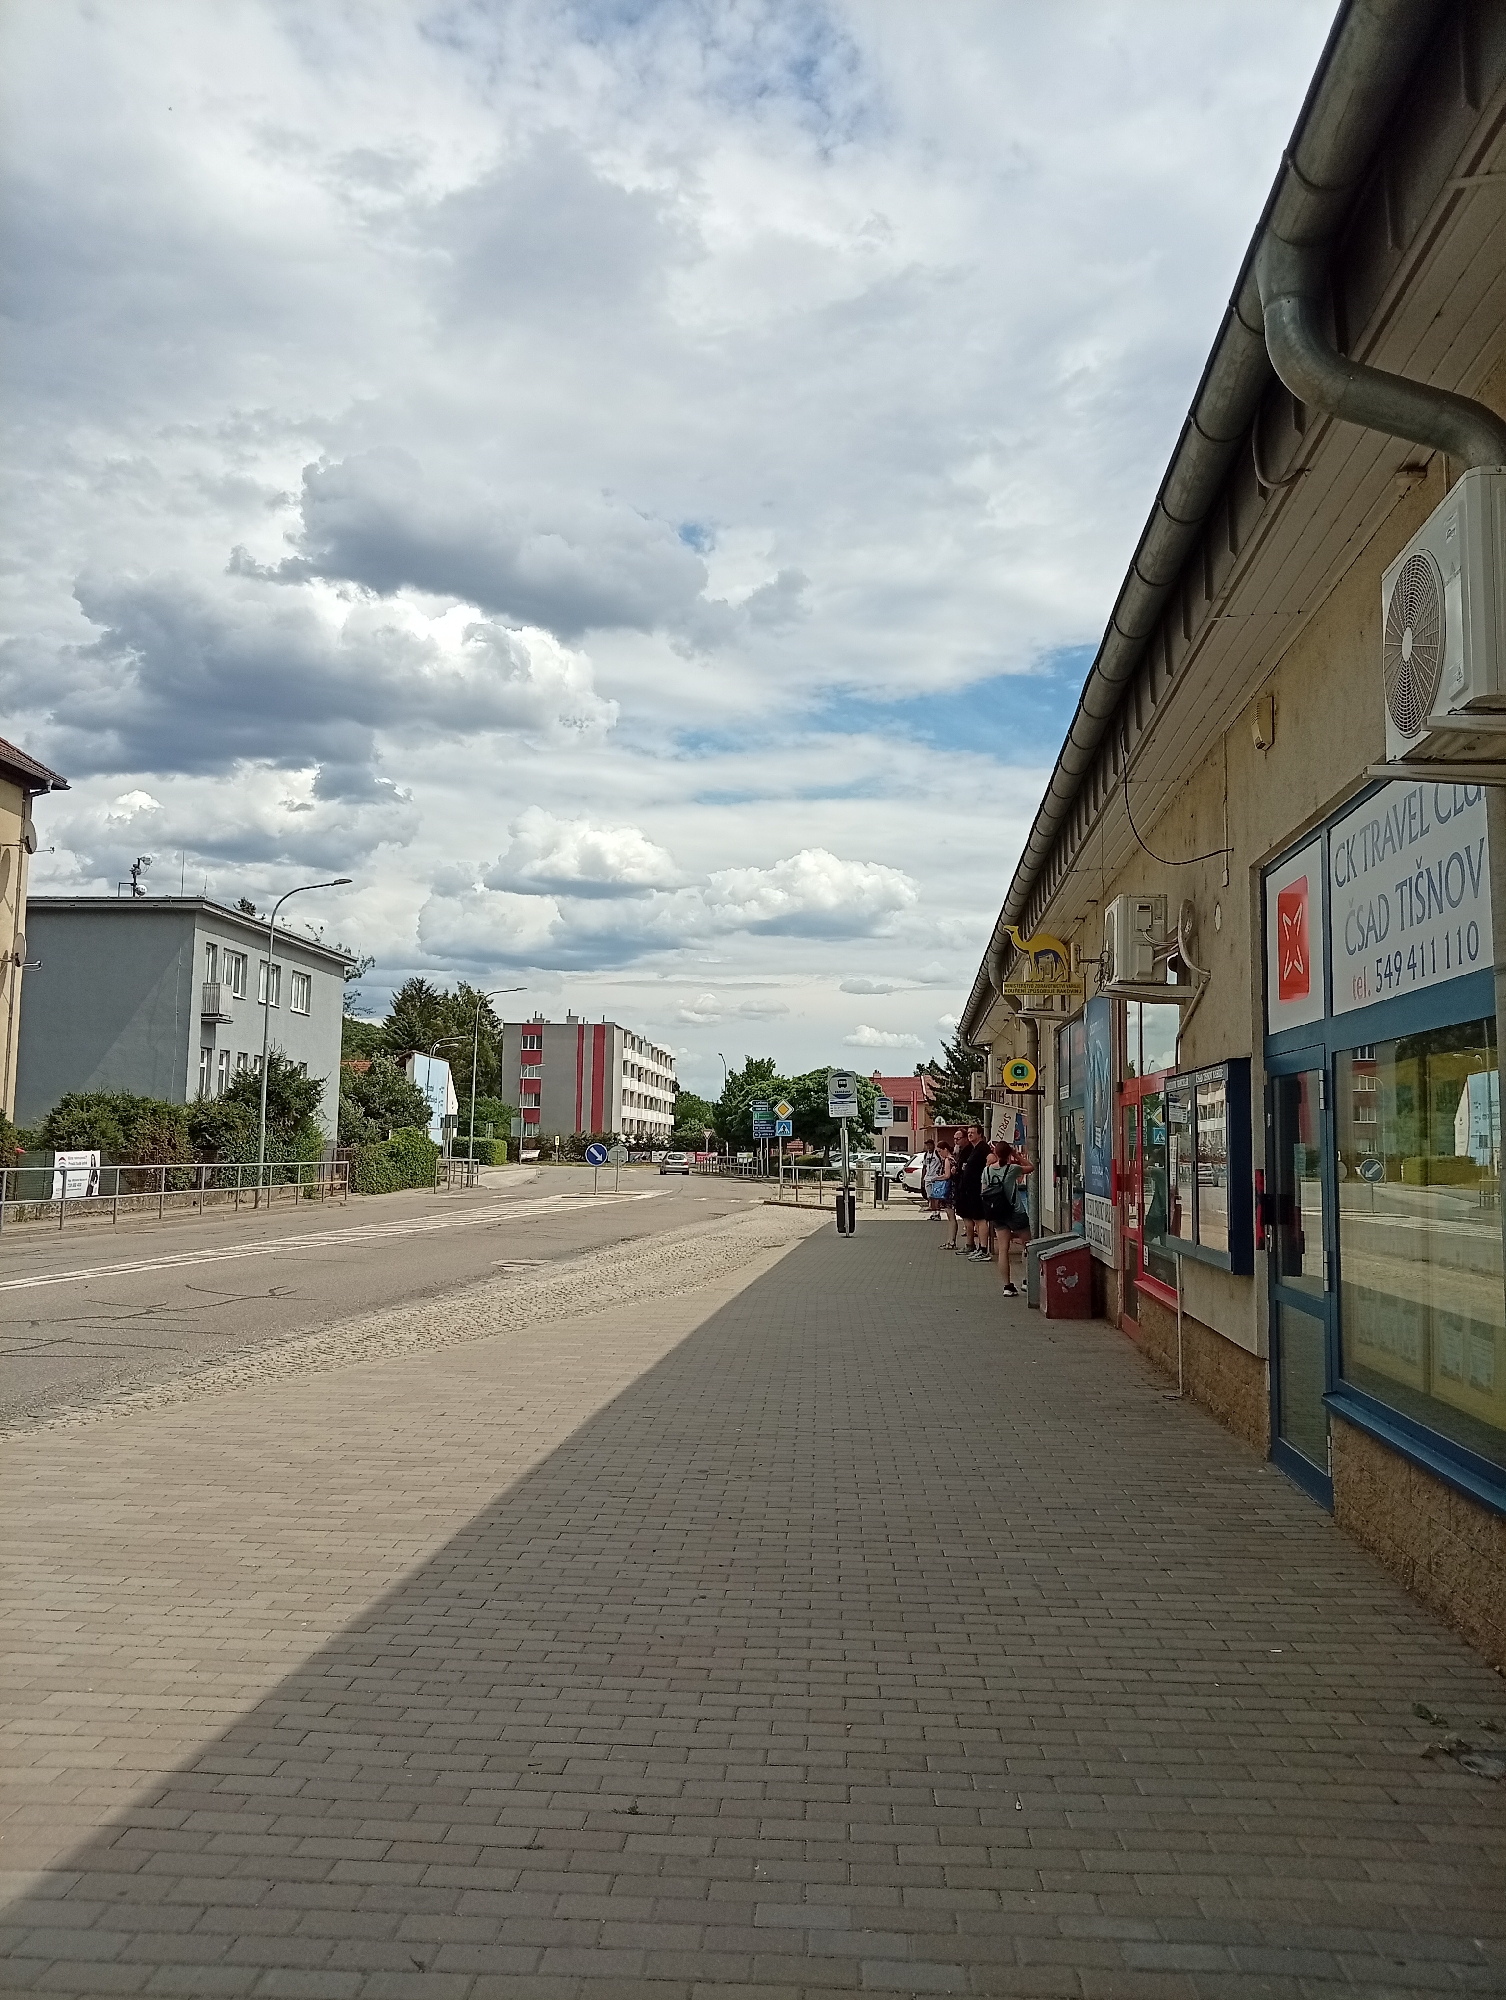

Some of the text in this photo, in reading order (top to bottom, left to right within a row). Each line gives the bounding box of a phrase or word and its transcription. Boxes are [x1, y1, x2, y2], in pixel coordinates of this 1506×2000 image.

[1334, 784, 1486, 888] CK TRAVEL CLU
[1345, 837, 1485, 956] ČSAD TIŠNOV
[1352, 965, 1371, 1000] tel.
[1376, 950, 1402, 992] 549
[1444, 920, 1479, 970] 110
[1009, 1081, 1029, 1089] allwyn
